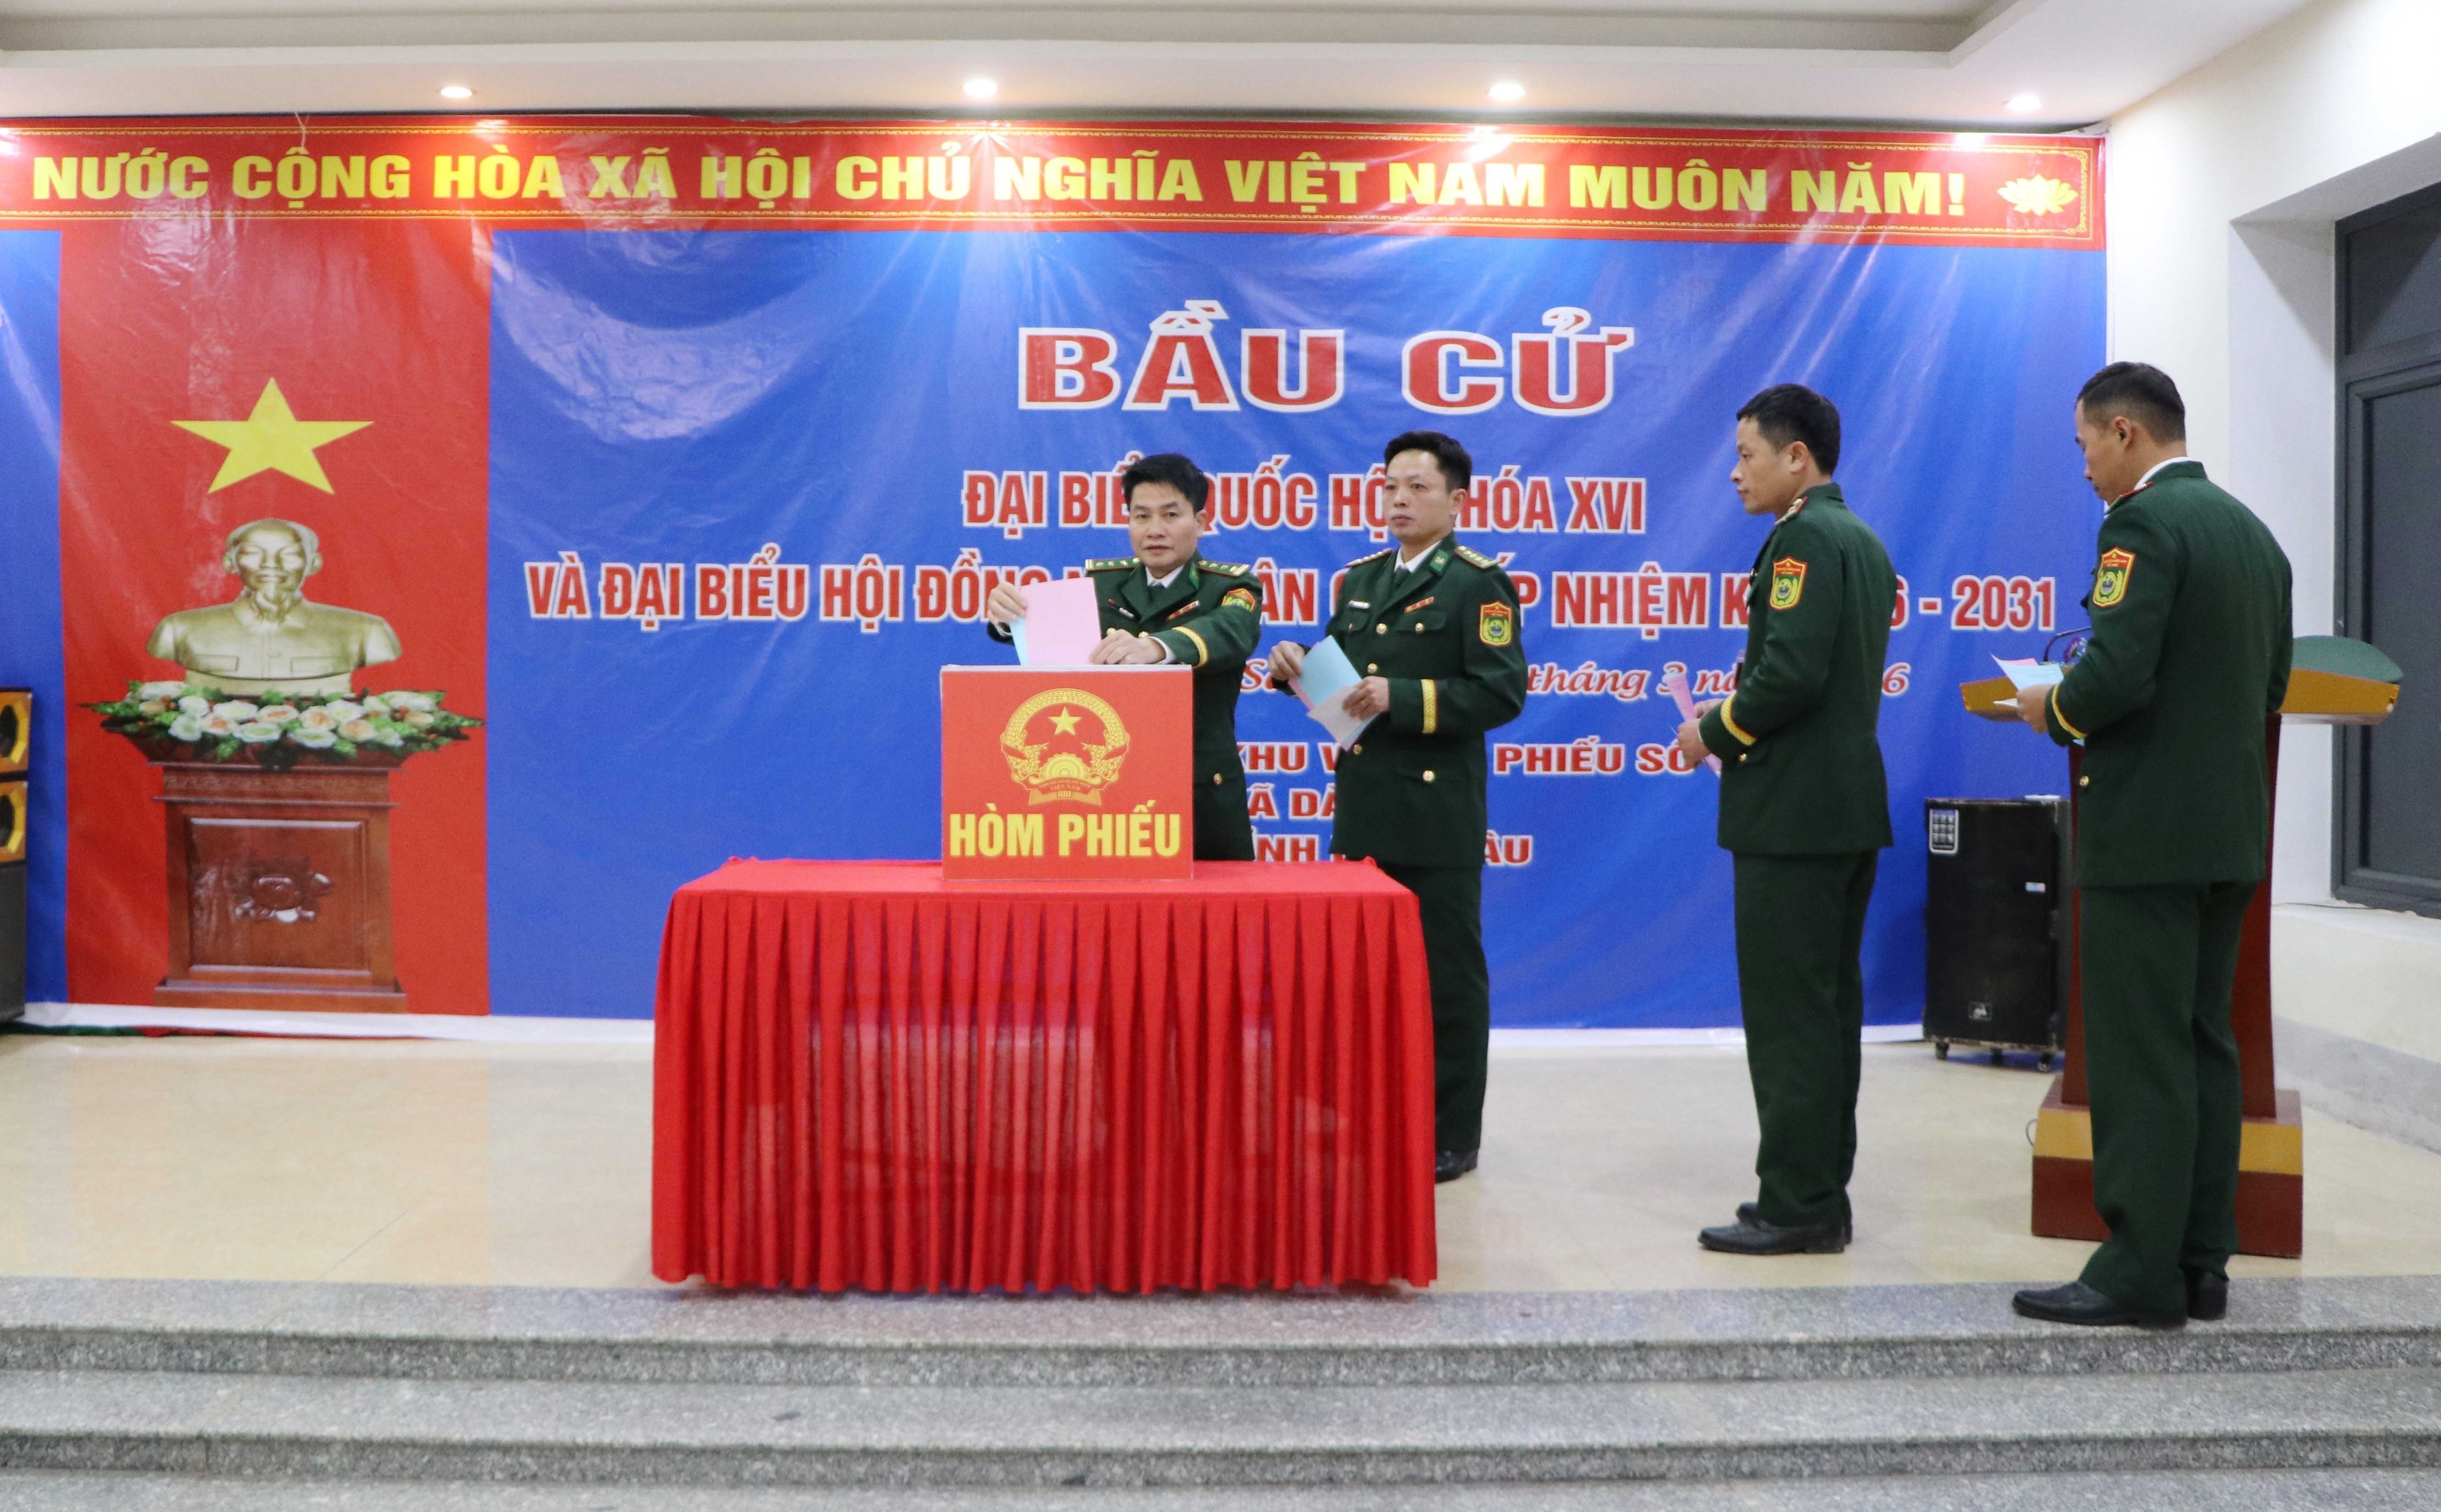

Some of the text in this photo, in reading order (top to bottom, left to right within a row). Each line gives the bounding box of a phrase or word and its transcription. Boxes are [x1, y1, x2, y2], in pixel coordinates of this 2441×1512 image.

[33, 141, 1966, 217] NƯỚC CỘNG HÒA XÃ HỘI CHỦ NGHĨA VIỆT NAM MUÔN NĂM!
[1018, 300, 1635, 416] BẦU CỬ
[961, 470, 1048, 539] ĐẠI
[1059, 451, 1142, 528] BIỂ
[1328, 463, 1389, 543] HỘ
[1454, 465, 1557, 534] HÓA
[1565, 476, 1647, 534] XVI
[524, 551, 592, 619] VÀ
[598, 561, 685, 631] ĐẠI
[695, 543, 810, 622] BIỂU
[819, 554, 904, 633] HỘI
[1552, 561, 1711, 640] NHIỆM
[1951, 574, 2056, 631] 2031
[1527, 661, 1651, 702] tháng
[1493, 735, 1625, 775] PHIẾU
[949, 800, 1181, 857] HÒM PHIẾU
